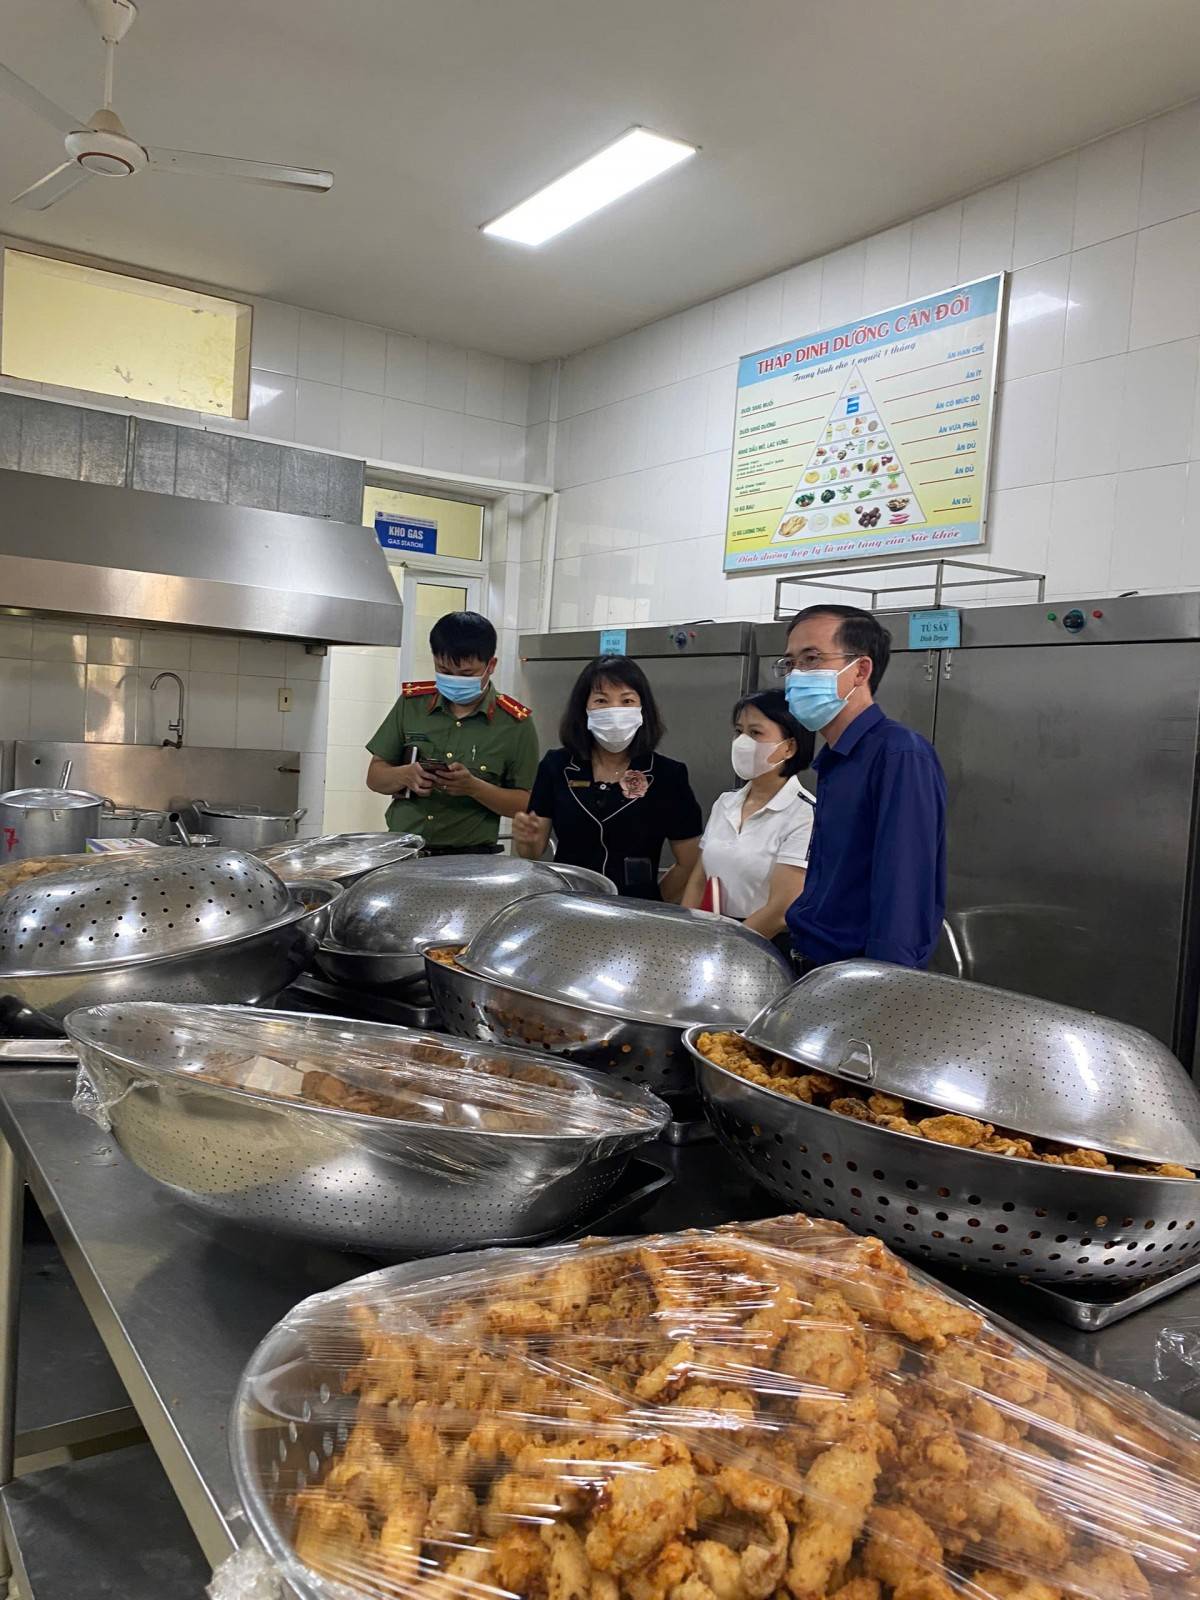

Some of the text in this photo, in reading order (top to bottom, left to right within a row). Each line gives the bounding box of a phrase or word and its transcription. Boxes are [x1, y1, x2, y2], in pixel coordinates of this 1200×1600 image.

[757, 292, 970, 375] THÁP DINH DƯỠNG CÂN ĐỐI
[793, 371, 815, 383] Trung
[835, 360, 849, 371] cho
[891, 342, 916, 355] tháng
[388, 526, 424, 540] KHO GAS
[401, 540, 424, 549] STATION
